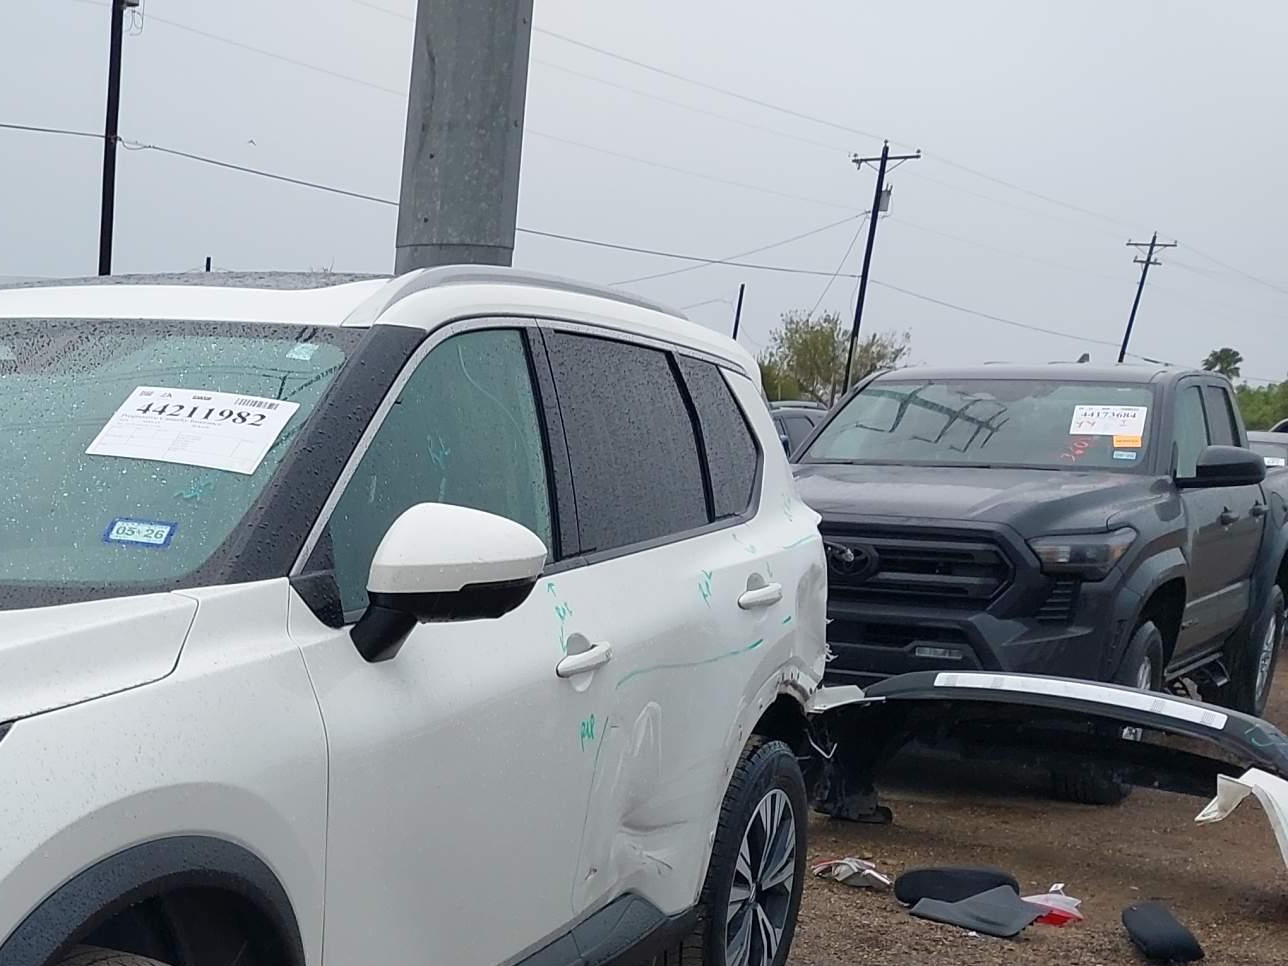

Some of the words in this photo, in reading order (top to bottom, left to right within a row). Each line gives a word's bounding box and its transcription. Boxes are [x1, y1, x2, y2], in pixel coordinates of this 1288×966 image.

[136, 402, 267, 427] 44211982
[116, 526, 137, 537] 05
[144, 528, 166, 540] 26
